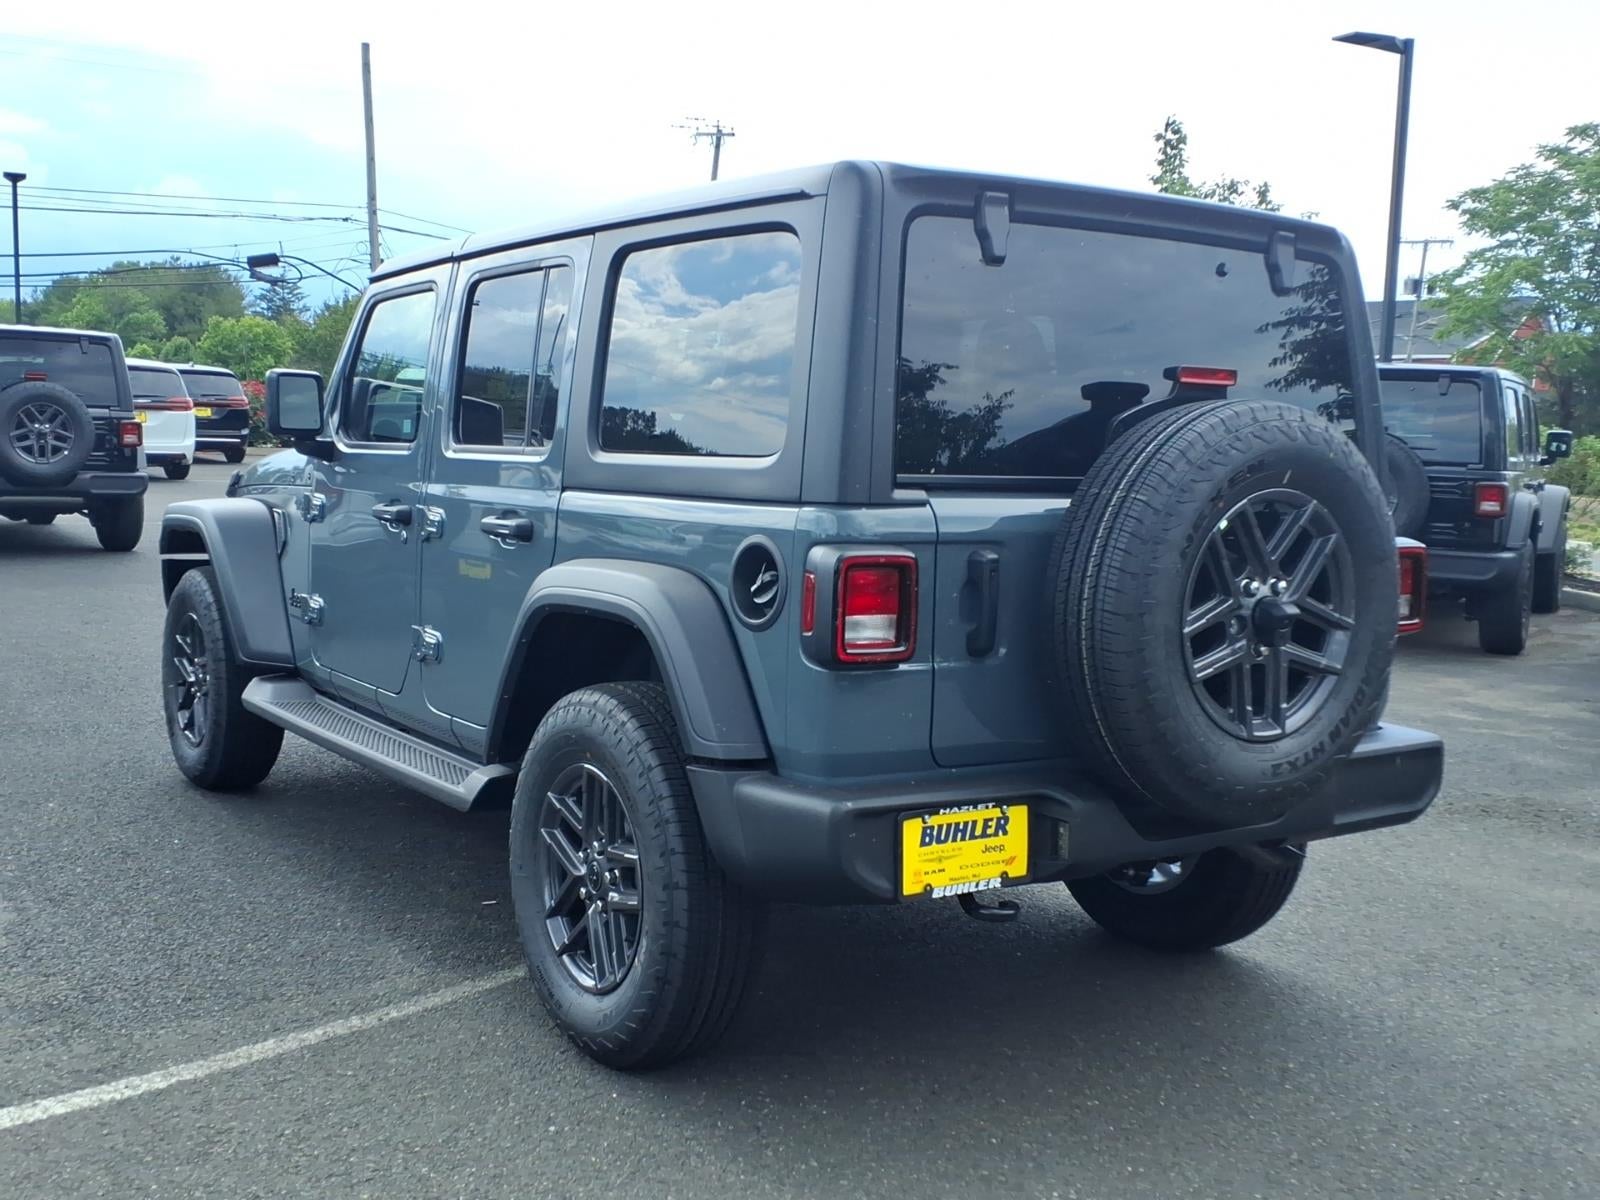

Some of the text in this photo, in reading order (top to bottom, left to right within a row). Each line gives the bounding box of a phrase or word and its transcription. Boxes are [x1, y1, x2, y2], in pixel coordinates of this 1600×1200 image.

[940, 802, 996, 815] HAZLET
[920, 815, 1010, 847] BUHLER
[981, 844, 1005, 854] Jeep
[924, 868, 946, 876] RAM
[932, 877, 1002, 898] BUHLER
